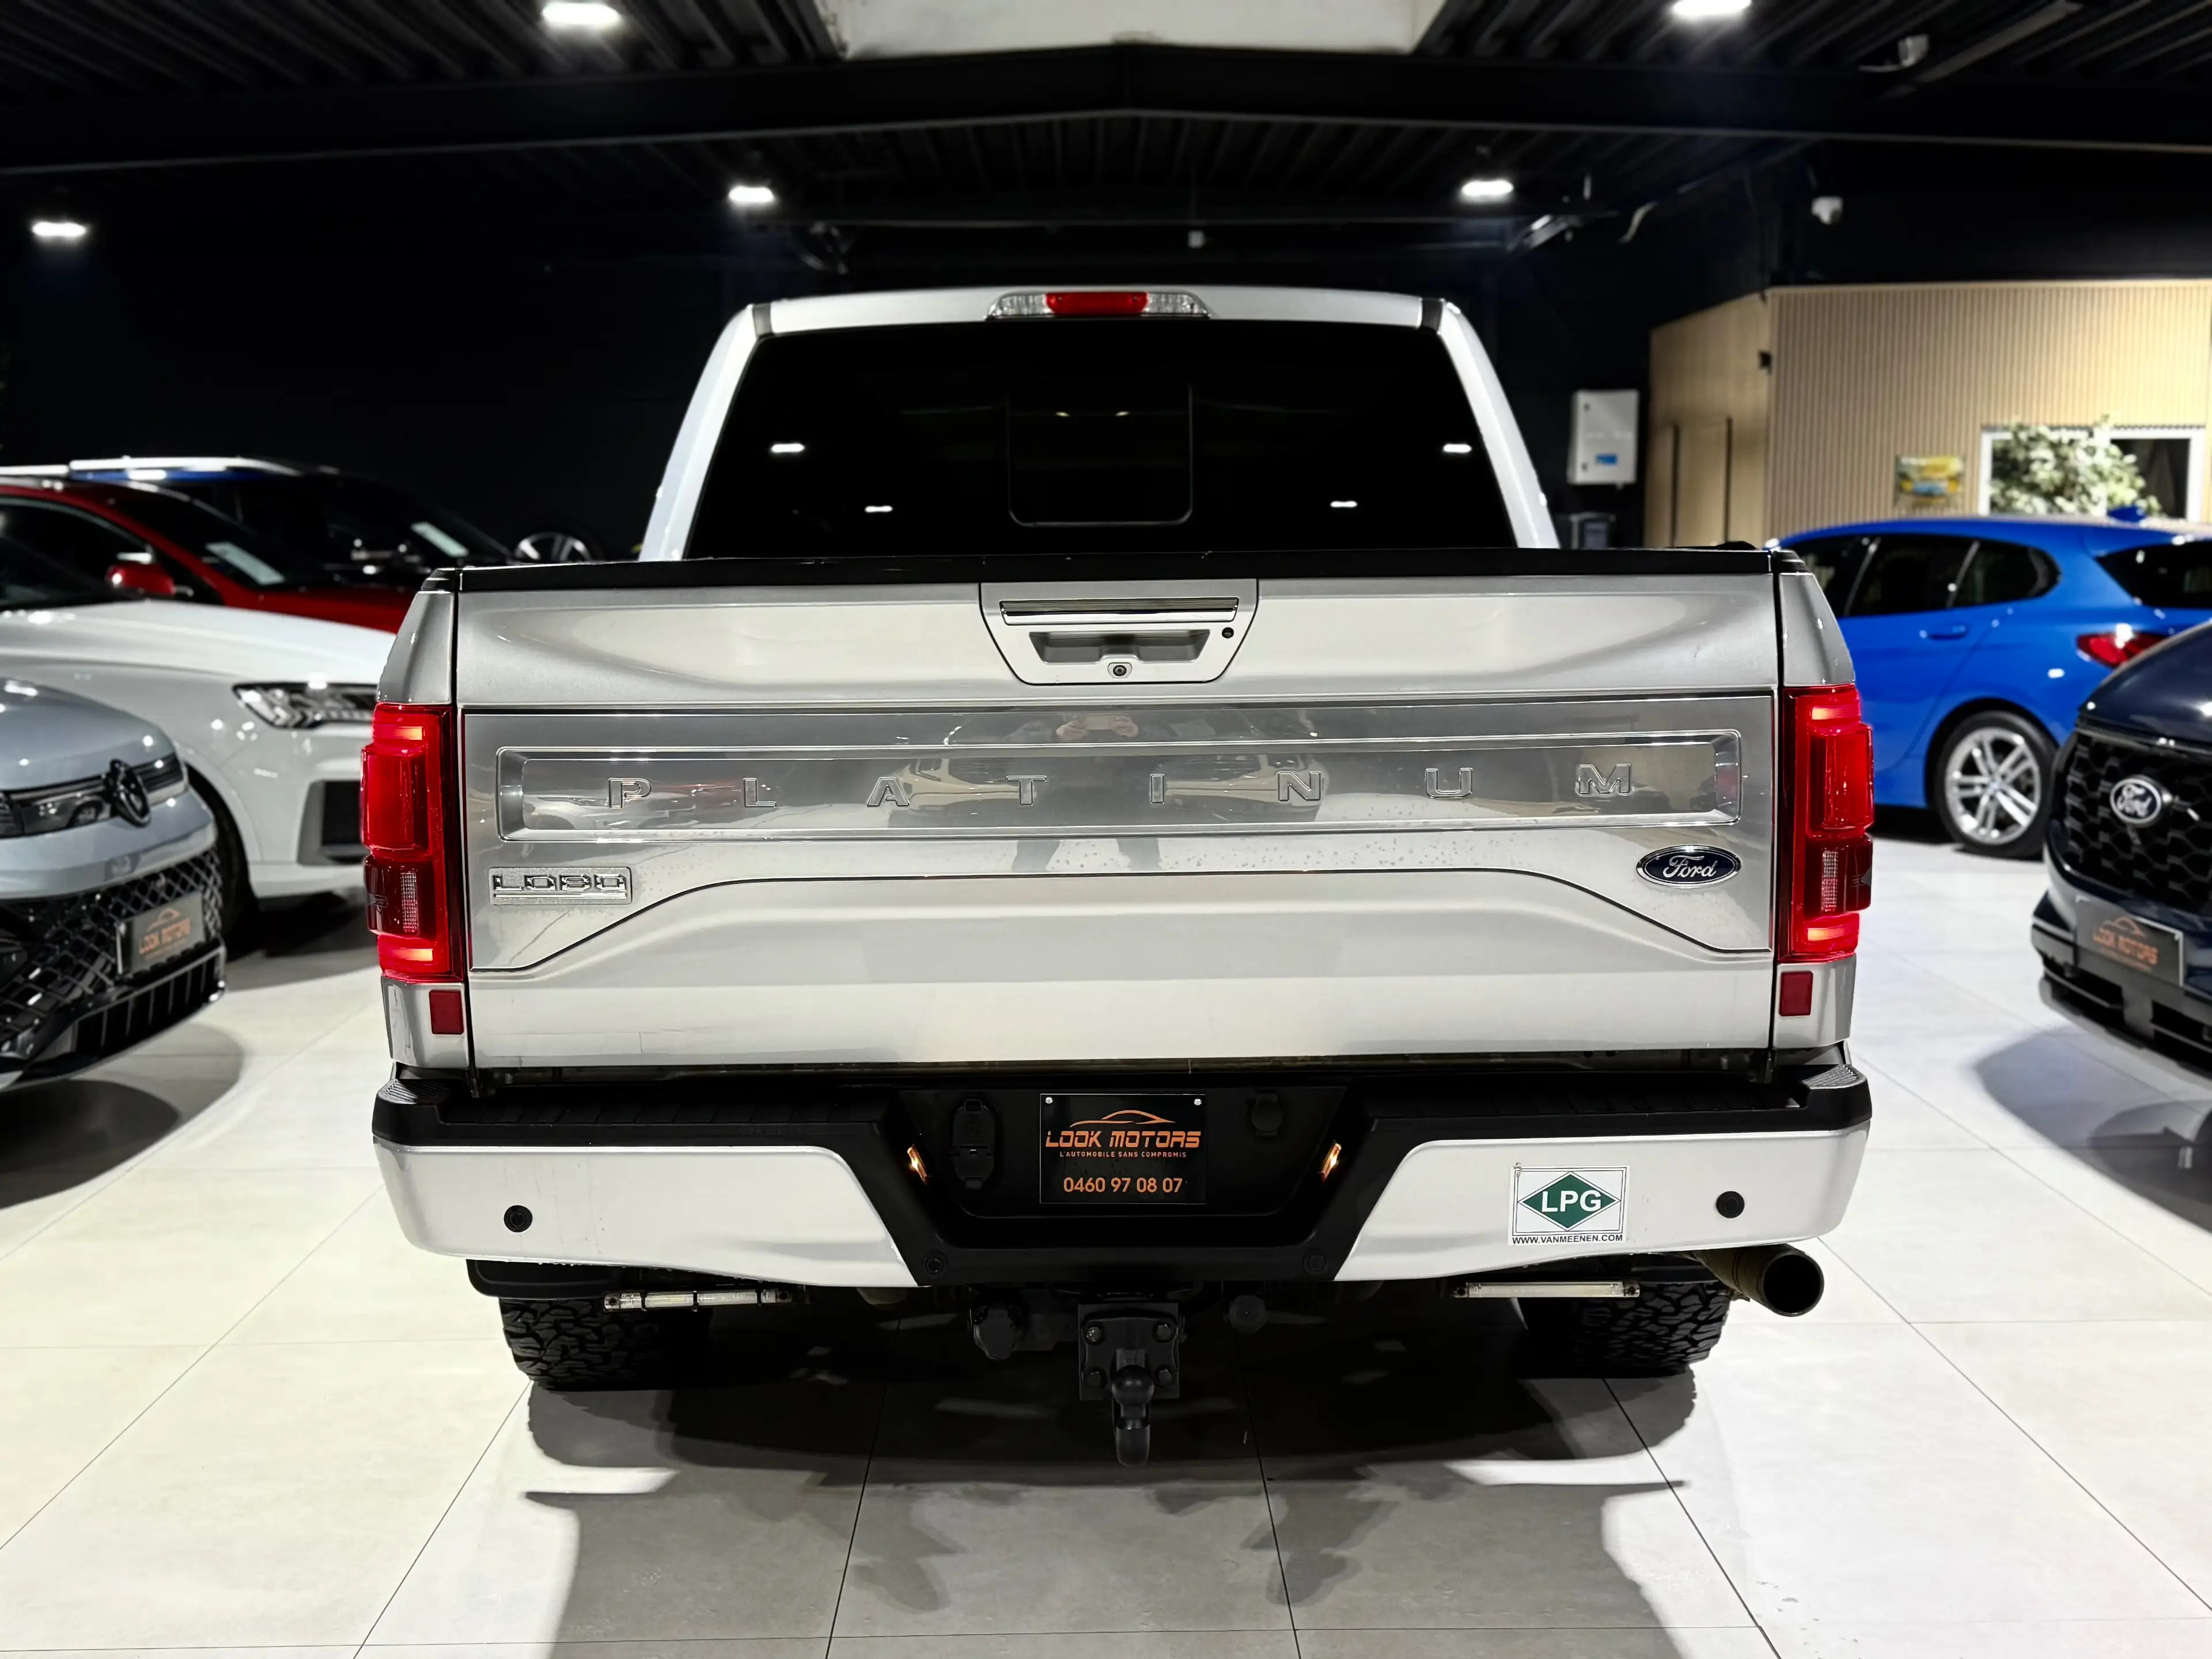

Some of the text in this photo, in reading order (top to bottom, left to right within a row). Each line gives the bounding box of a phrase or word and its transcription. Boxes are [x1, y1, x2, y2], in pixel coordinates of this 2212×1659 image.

[608, 764, 1631, 808] PLATINUM
[1662, 855, 1718, 878] Ford
[1045, 1130, 1202, 1148] LOOK MOTORS
[1063, 1177, 1183, 1193] 0460 97 08 07
[1541, 1190, 1602, 1213] LPG
[1512, 1234, 1623, 1244] WWW.VANMEENEN.COM
